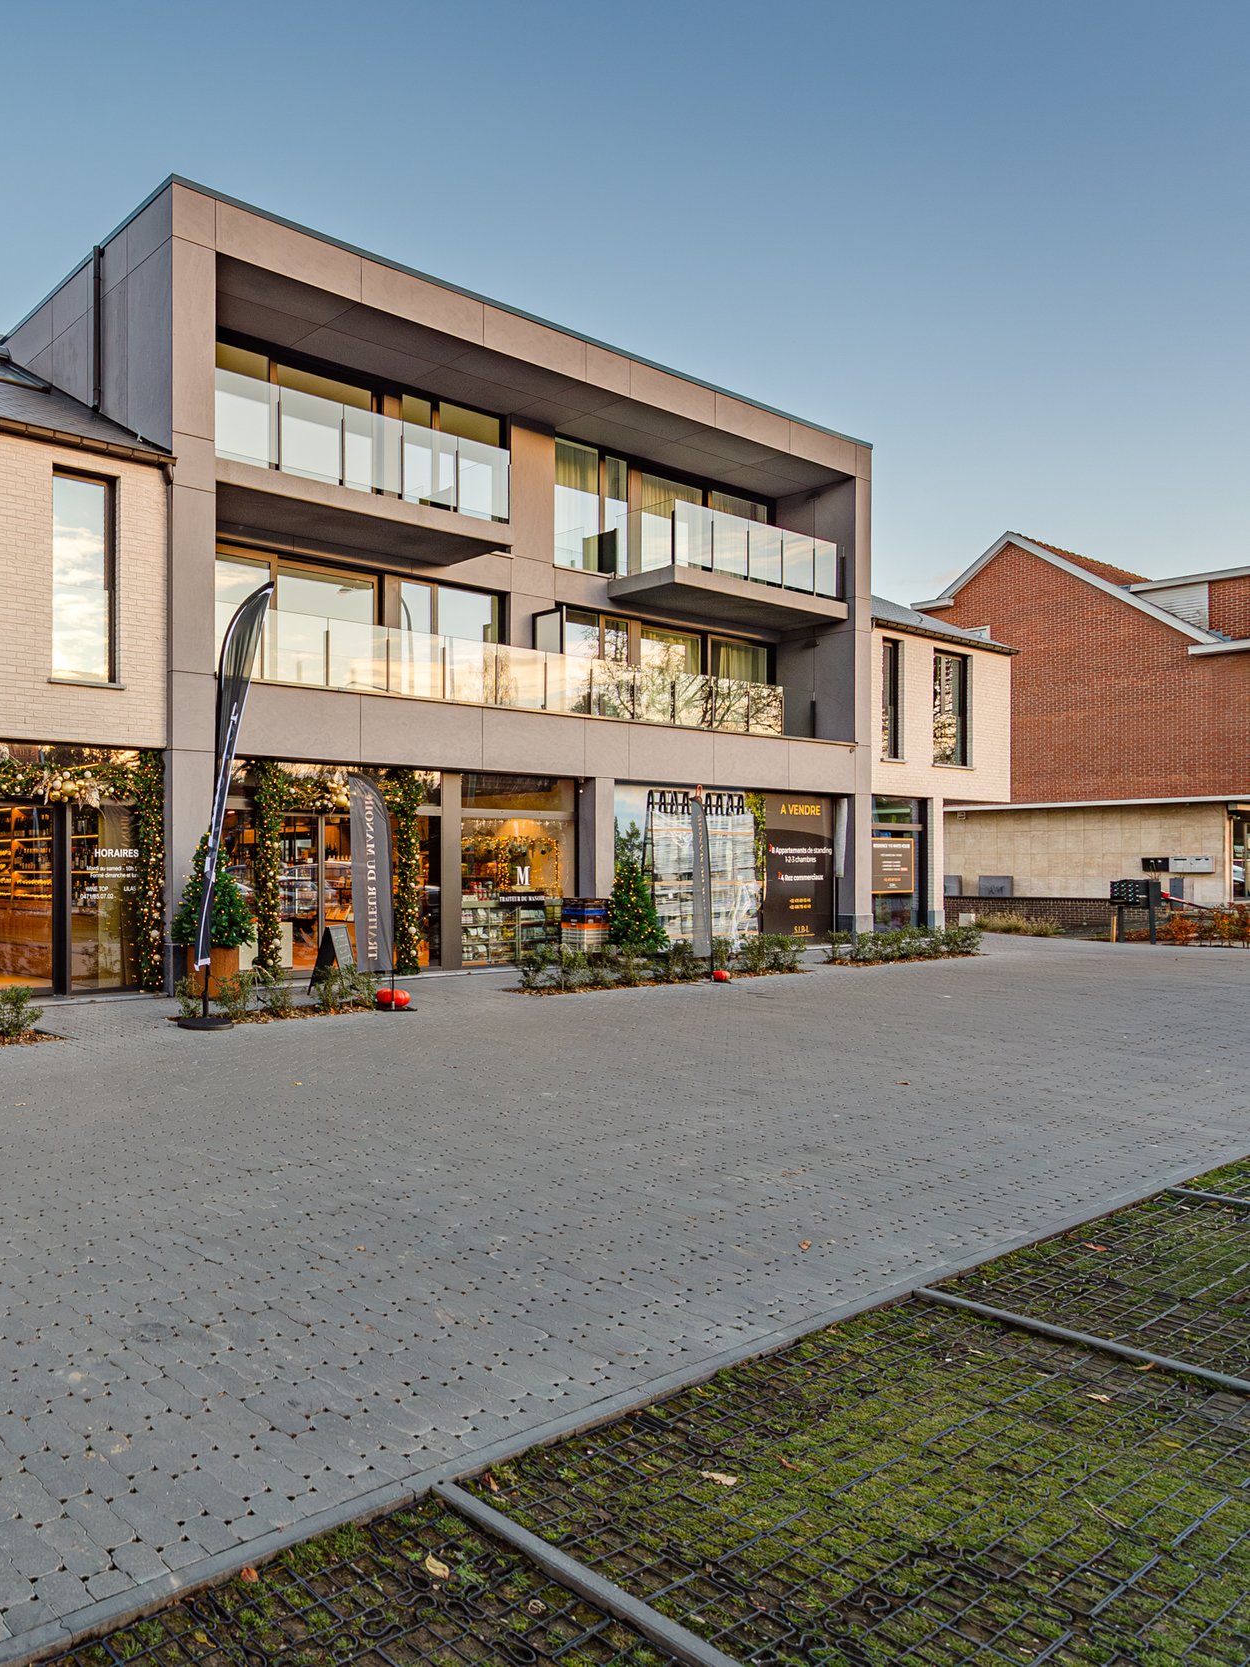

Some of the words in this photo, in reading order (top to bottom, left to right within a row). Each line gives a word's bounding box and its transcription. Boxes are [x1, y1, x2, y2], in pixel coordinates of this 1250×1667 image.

[780, 803, 787, 815] A
[788, 804, 821, 816] VENDRE
[94, 848, 139, 858] HORAIRES
[776, 847, 807, 856] Appartements
[814, 847, 833, 856] standing
[516, 865, 530, 886] M
